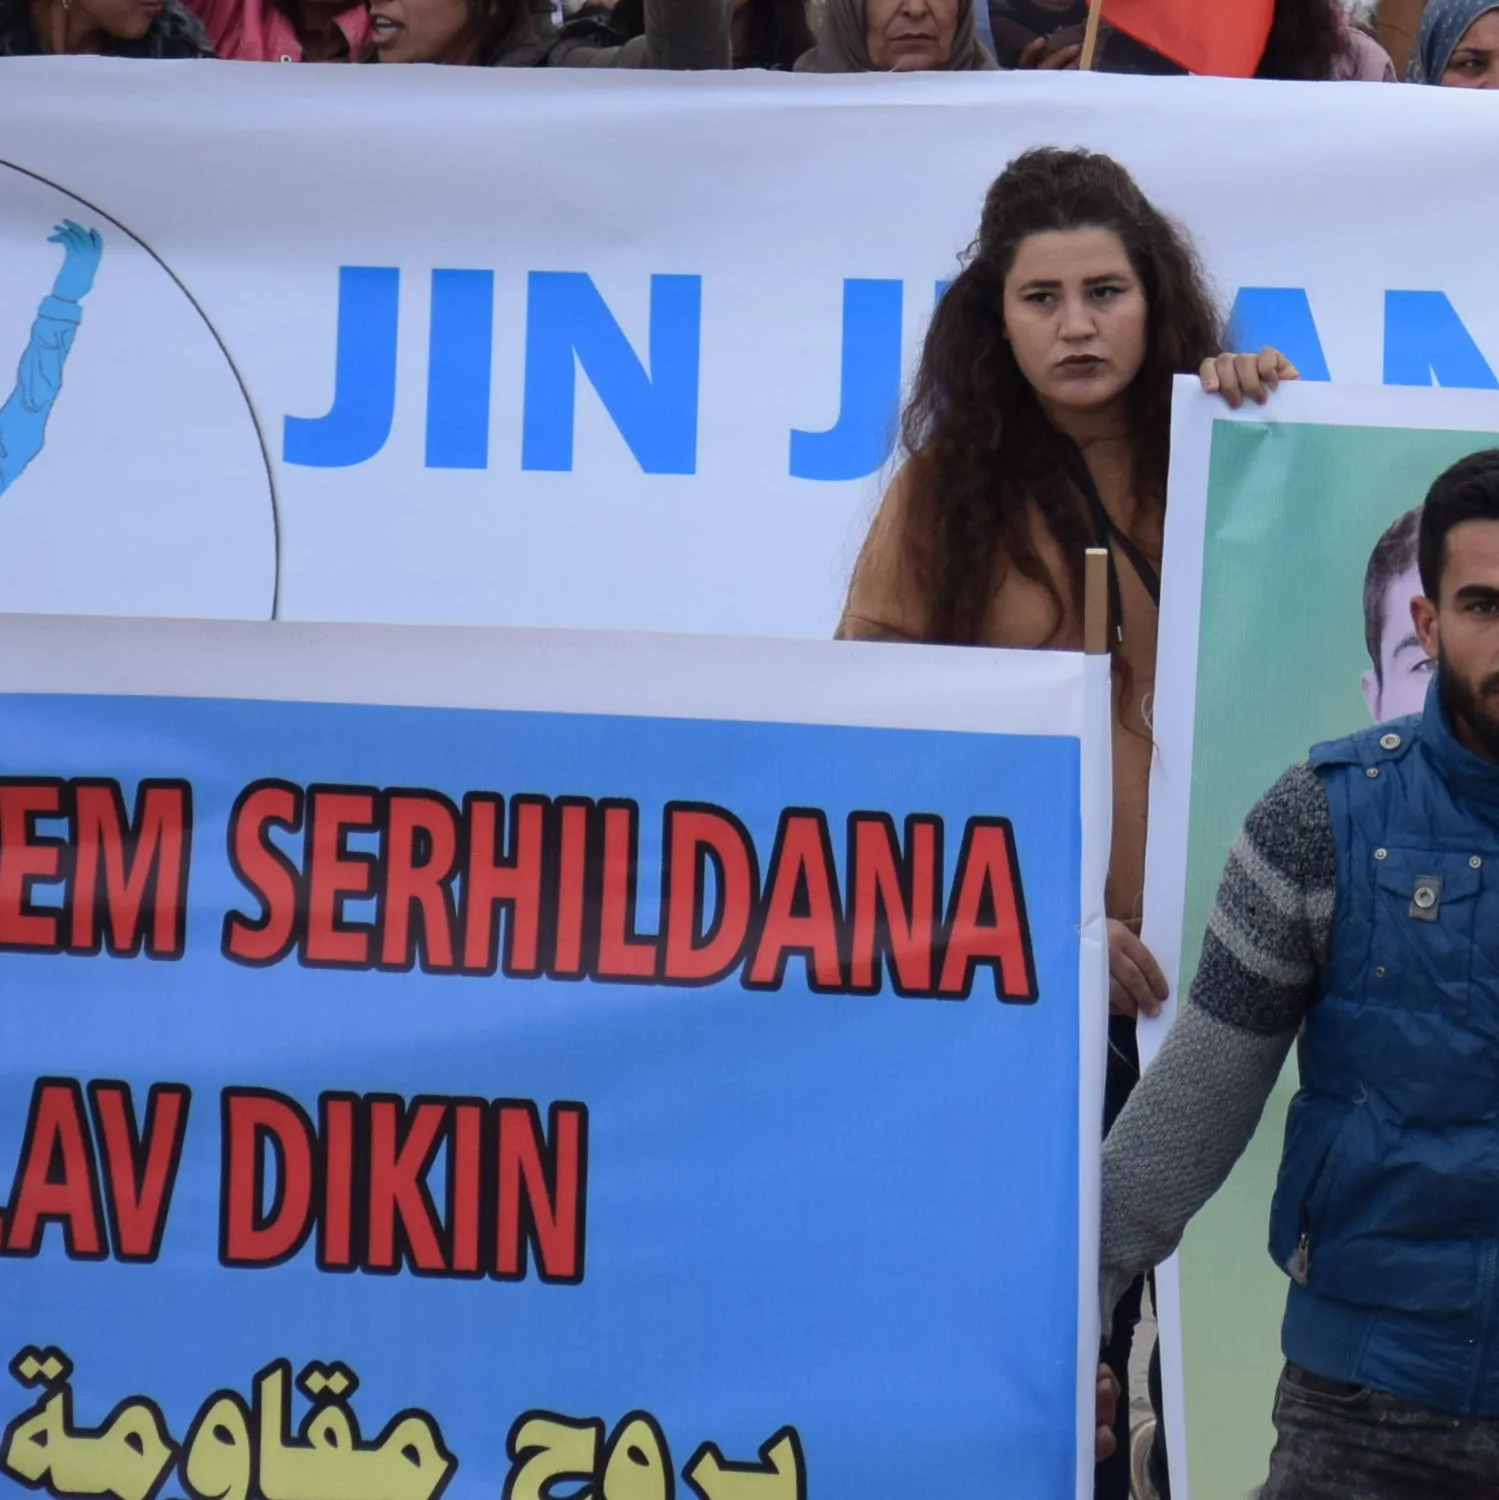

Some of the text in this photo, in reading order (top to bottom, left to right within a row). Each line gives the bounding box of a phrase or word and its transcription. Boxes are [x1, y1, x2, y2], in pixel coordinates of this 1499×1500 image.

[282, 265, 702, 476] JIN
[221, 777, 1039, 1004] SERHILDANA
[217, 1083, 590, 1286] DIKIN
